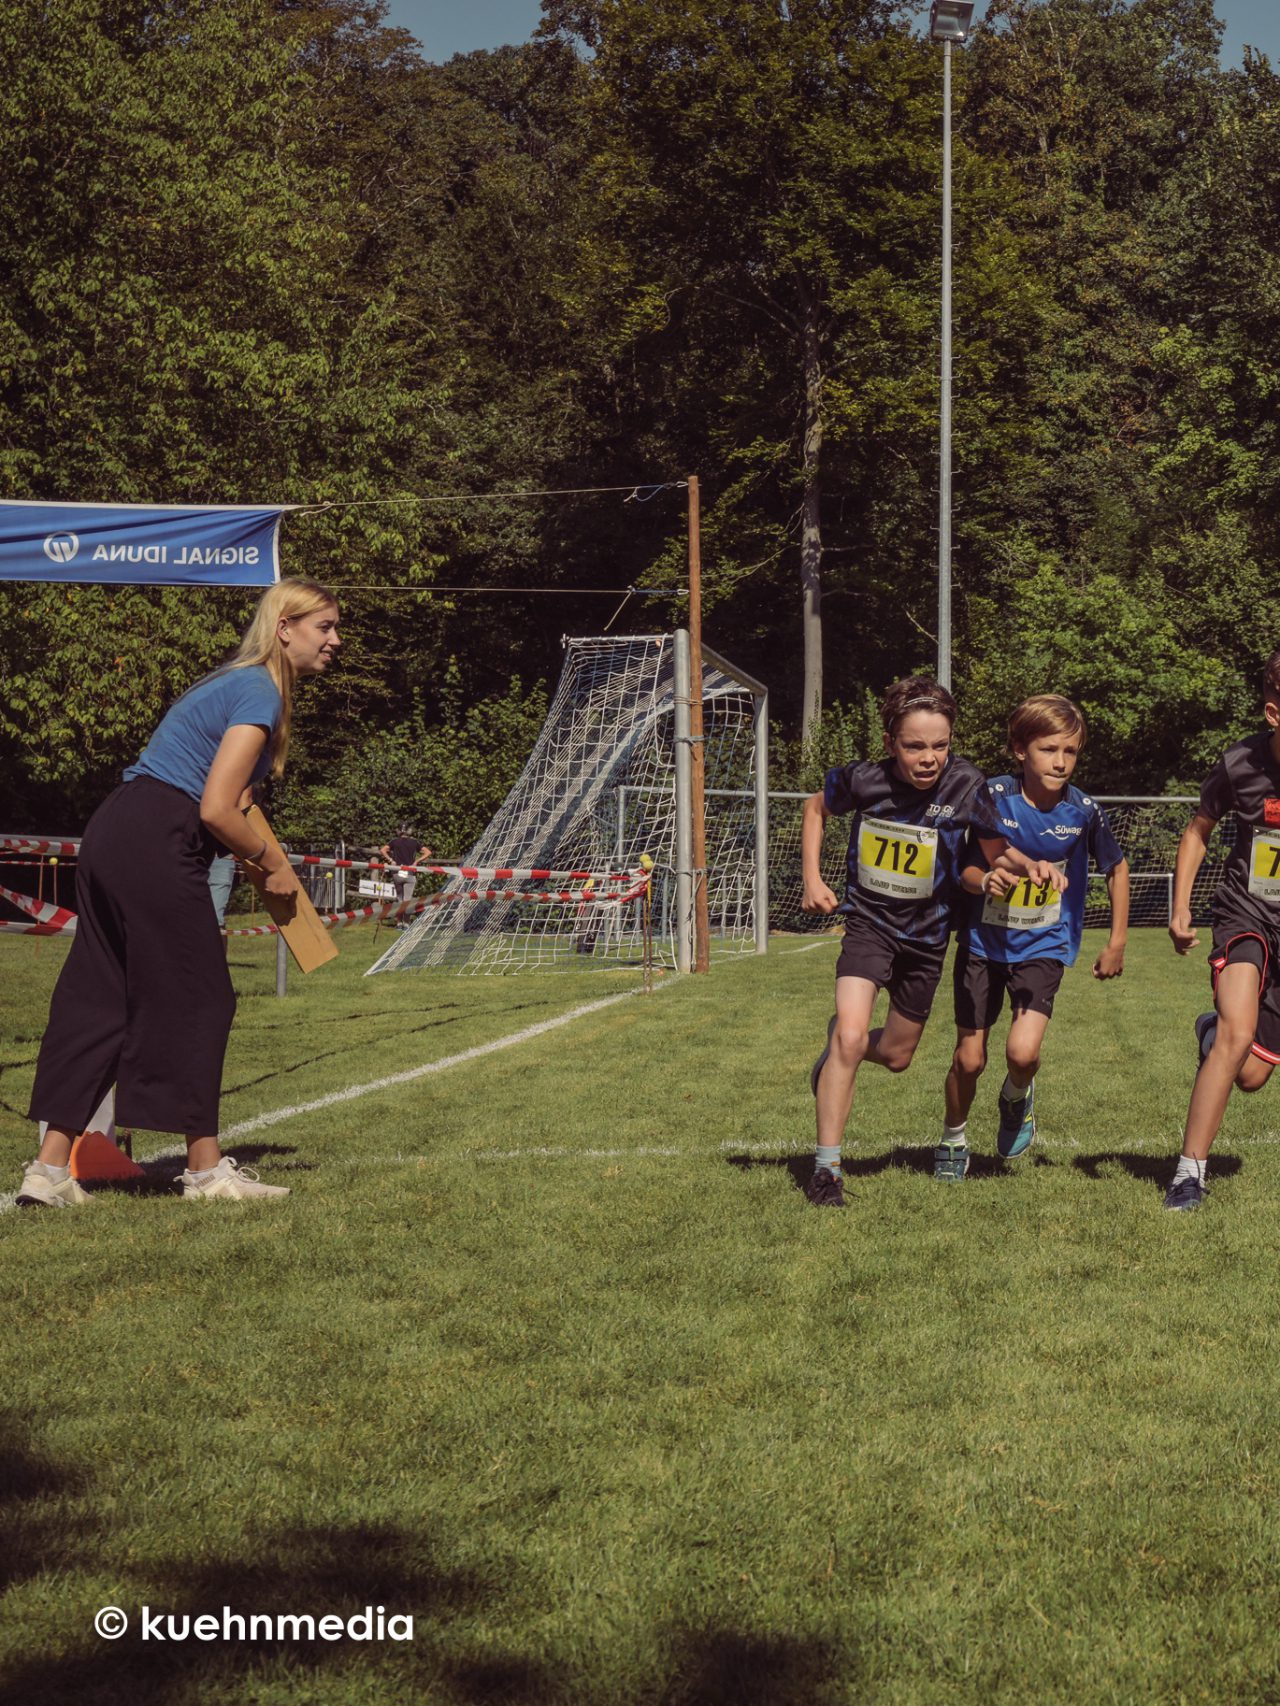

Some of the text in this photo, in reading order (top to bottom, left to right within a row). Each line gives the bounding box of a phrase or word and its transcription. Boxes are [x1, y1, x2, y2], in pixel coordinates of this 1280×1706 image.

[1001, 817, 1018, 829] AKO
[1055, 825, 1082, 836] Süwag
[874, 836, 919, 875] 712
